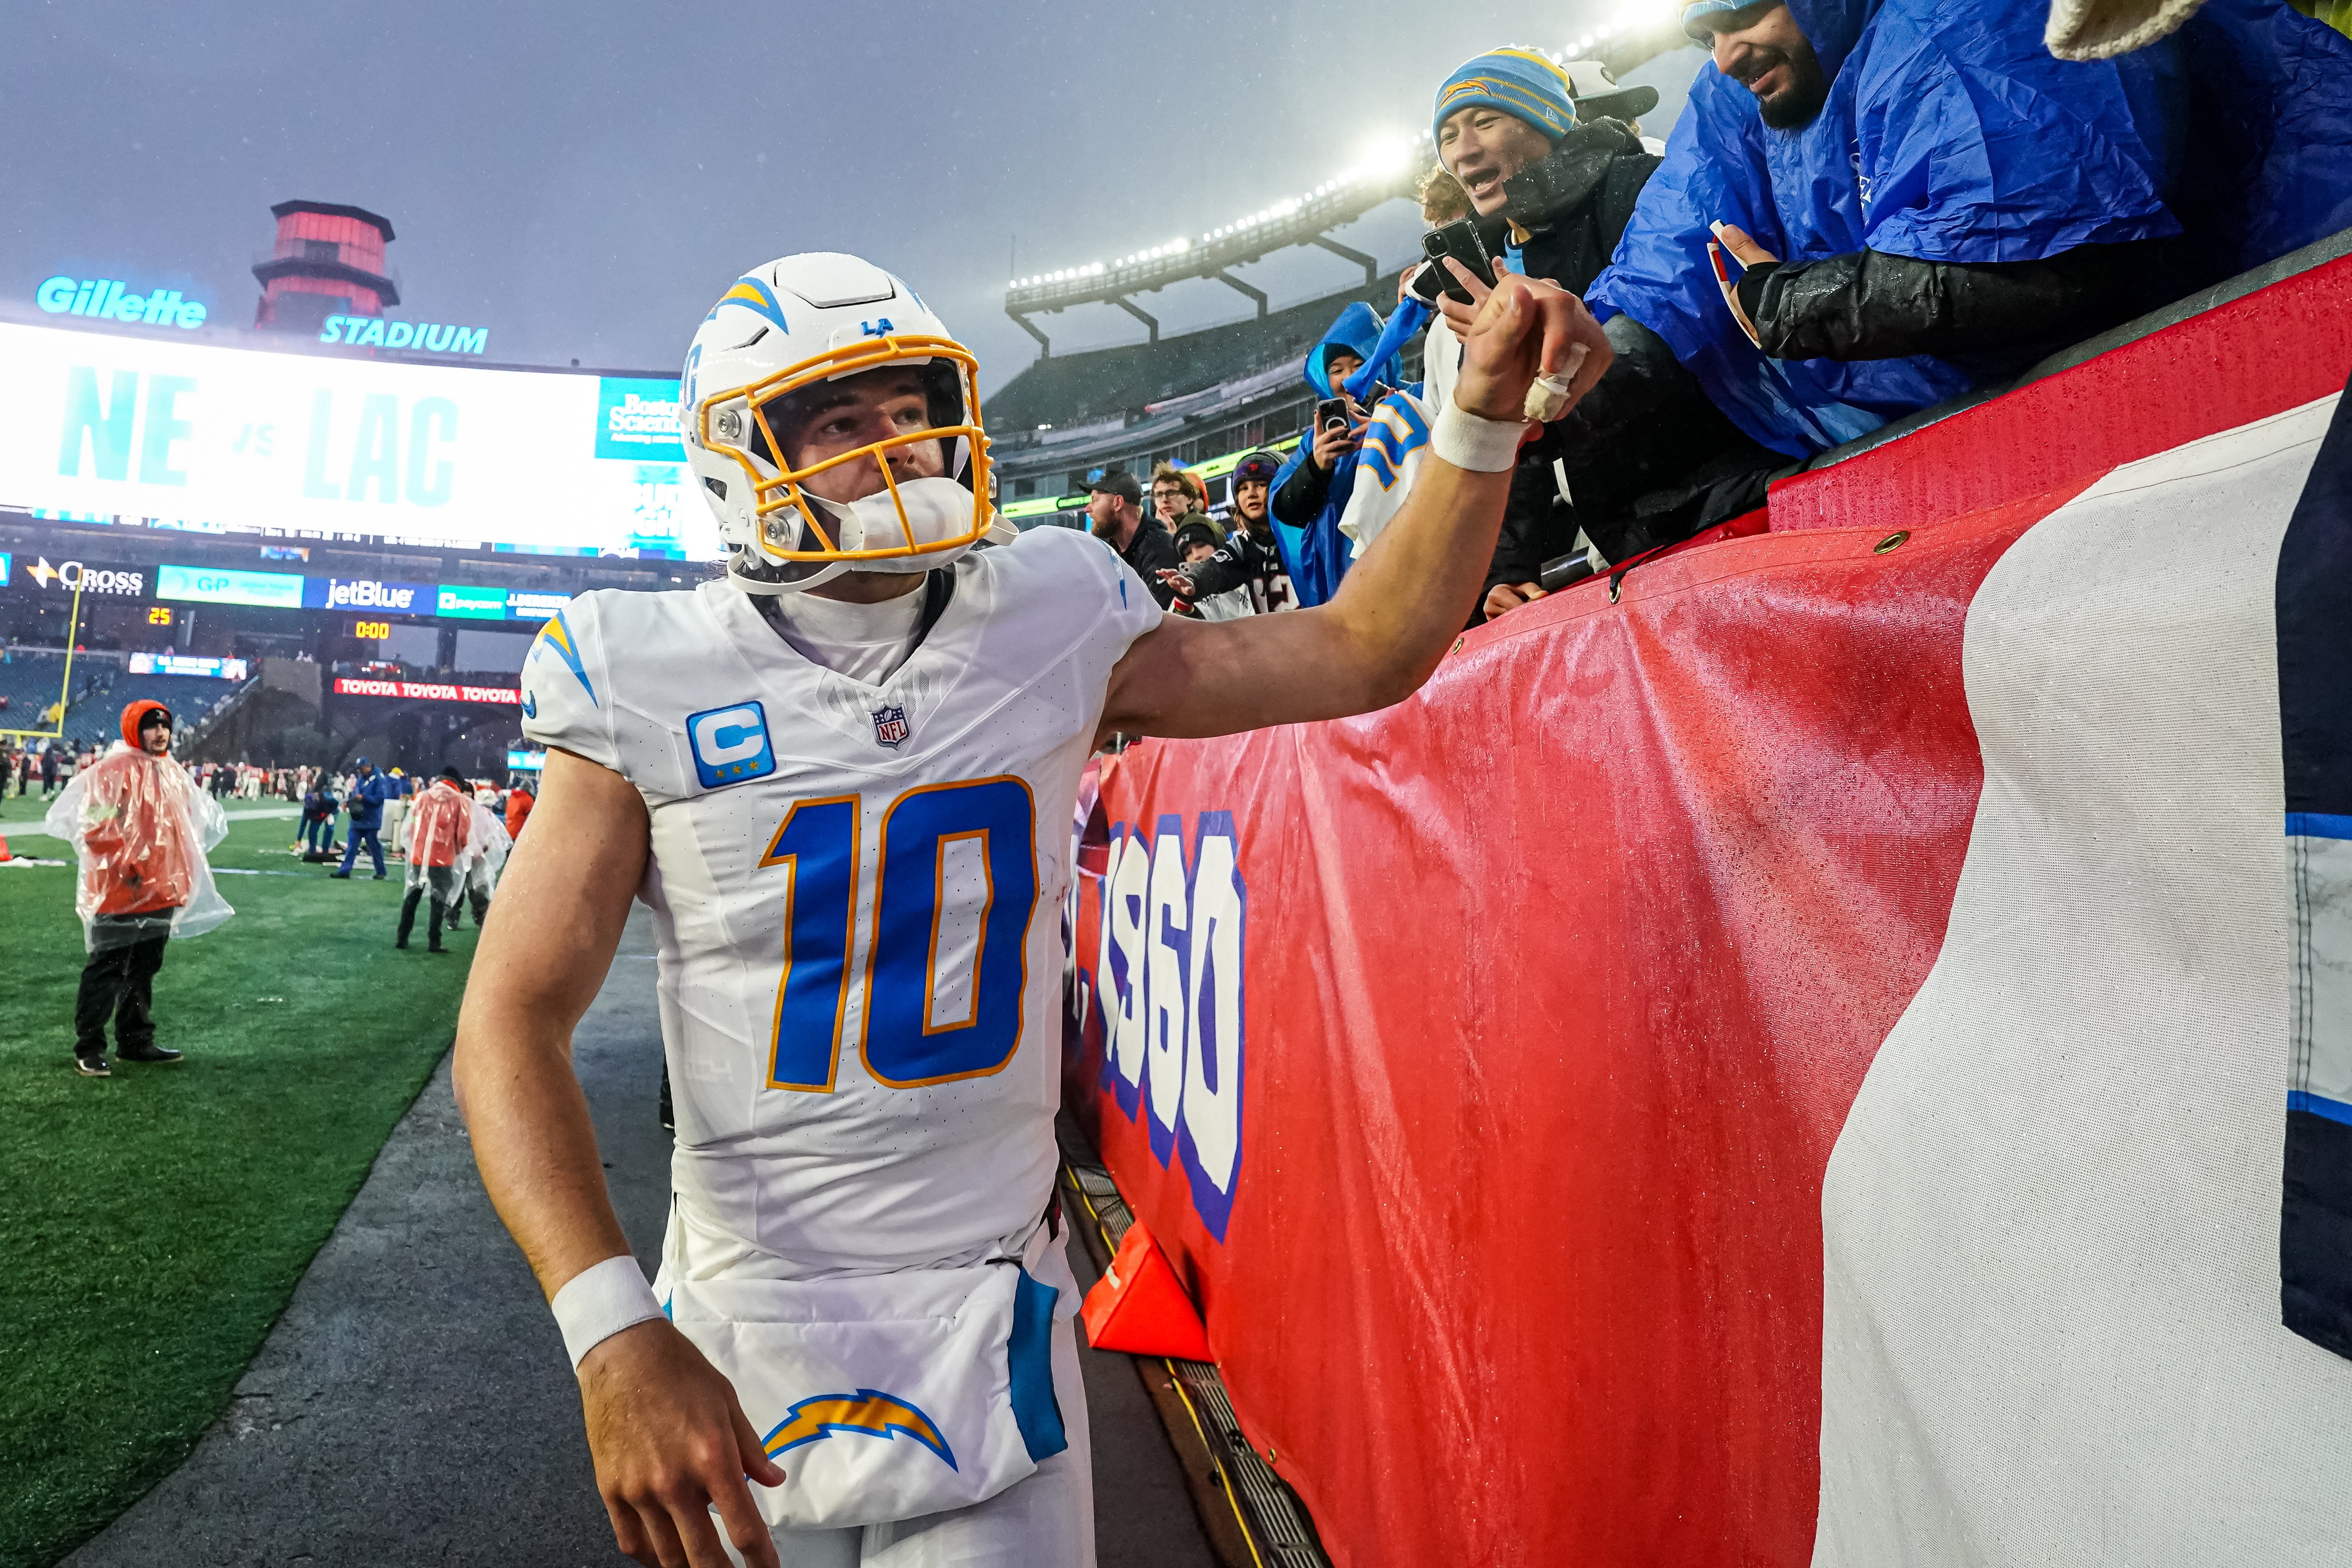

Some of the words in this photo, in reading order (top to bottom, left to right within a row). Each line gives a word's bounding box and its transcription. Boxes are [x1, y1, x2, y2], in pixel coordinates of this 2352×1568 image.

[36, 276, 207, 329] Gillette
[320, 315, 488, 354] STADIUM
[861, 318, 894, 338] LA
[57, 364, 197, 487] NE
[302, 388, 459, 508] LAC
[58, 561, 143, 591] CROSS
[325, 578, 412, 609] jetBlue
[148, 607, 171, 626] 25
[355, 621, 390, 640] 0:00
[341, 679, 398, 696] TOYOTA
[402, 682, 458, 700] TOYOTA
[462, 686, 517, 704] TOYOTA
[695, 707, 765, 766] C
[879, 721, 907, 740] NFL
[758, 774, 1040, 1094] 10
[1096, 821, 1244, 1218] 1960
